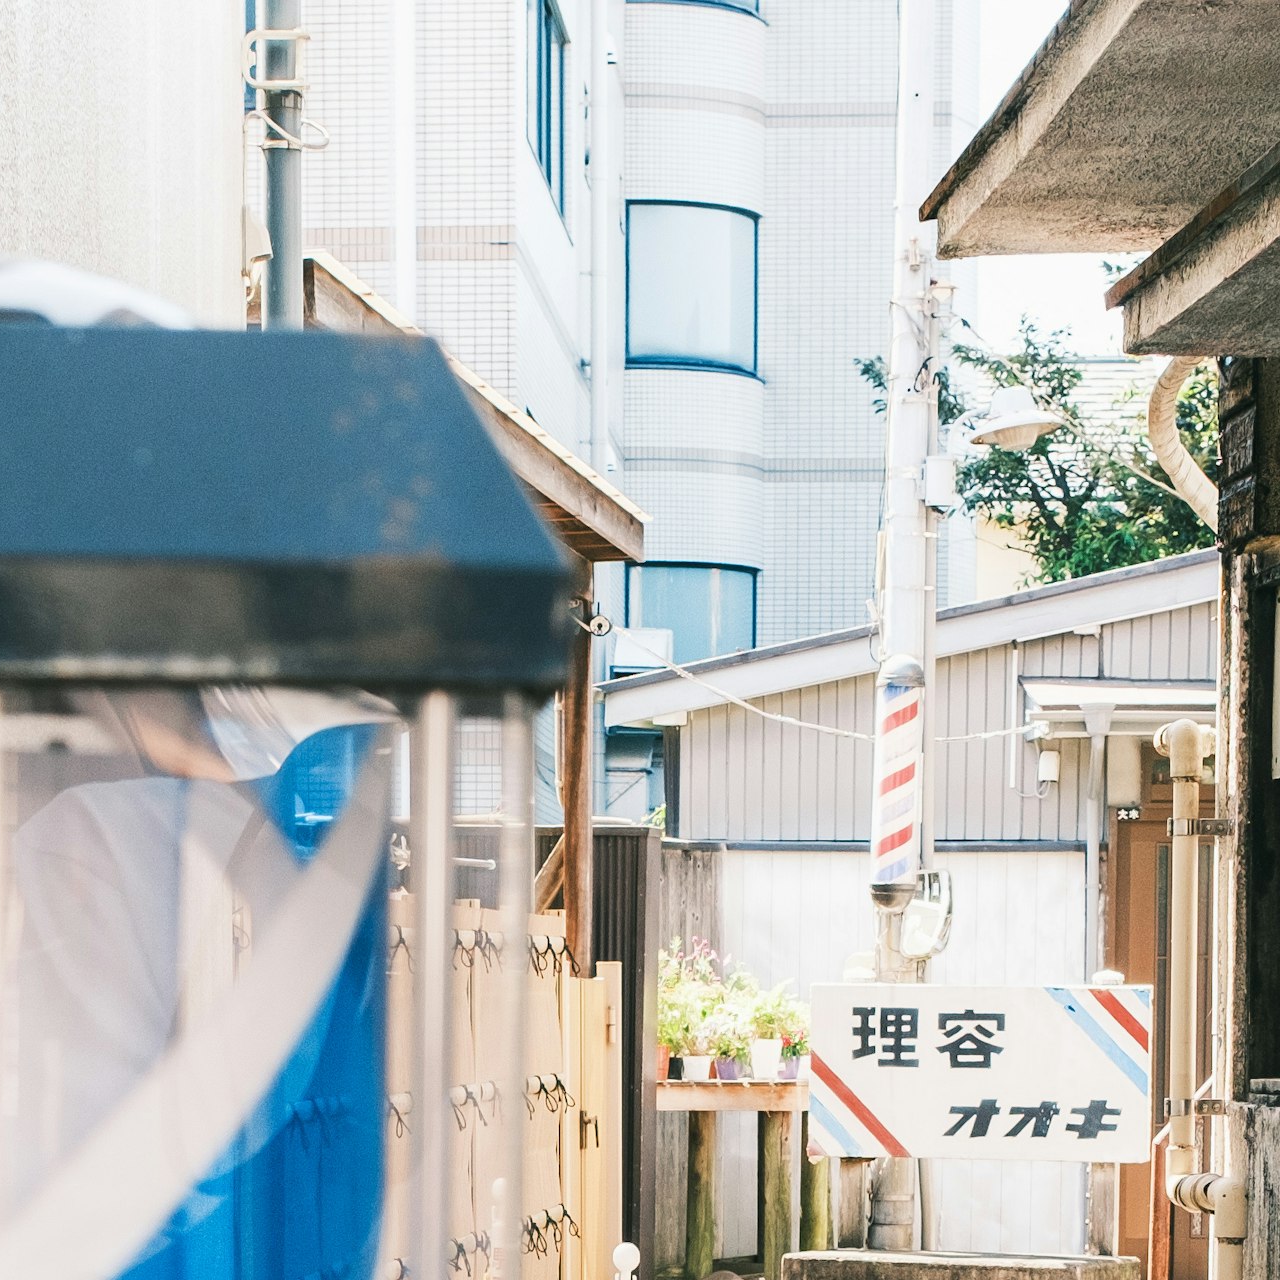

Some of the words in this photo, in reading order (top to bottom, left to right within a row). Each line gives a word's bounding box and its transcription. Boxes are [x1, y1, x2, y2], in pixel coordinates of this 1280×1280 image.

[852, 1007, 1005, 1068] 理容
[943, 1099, 1122, 1139] オオキ
